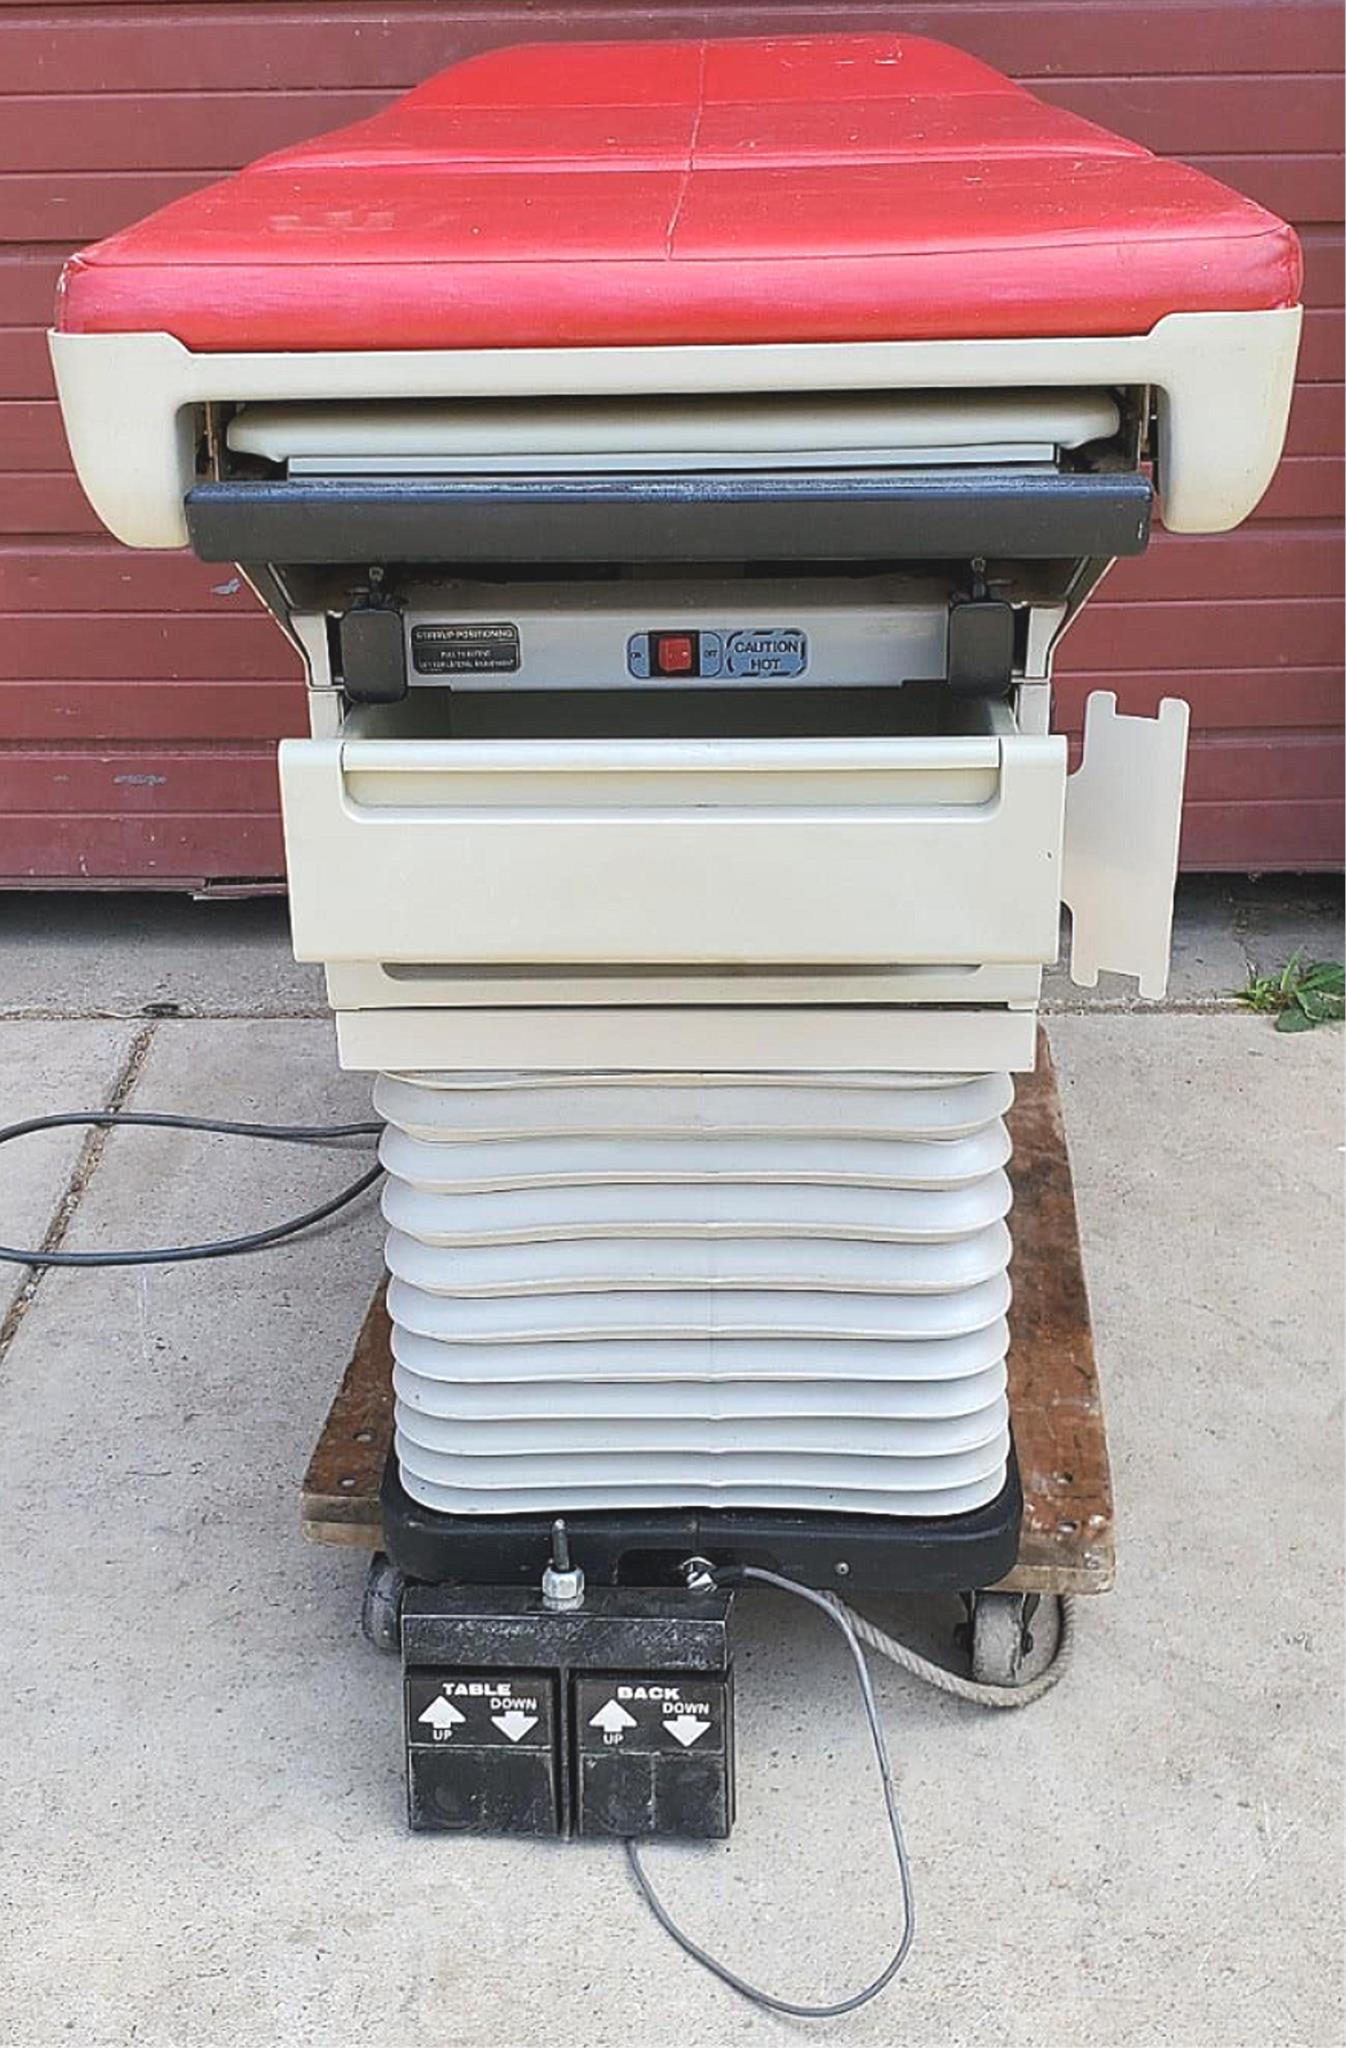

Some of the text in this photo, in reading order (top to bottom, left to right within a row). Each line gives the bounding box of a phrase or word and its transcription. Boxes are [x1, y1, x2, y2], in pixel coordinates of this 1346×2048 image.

[735, 641, 798, 653] CAUTION
[751, 659, 780, 670] HOT
[442, 1683, 511, 1696] TABLE
[617, 1686, 680, 1700] BACK
[490, 1697, 537, 1710] DOWN
[662, 1702, 709, 1714] DOWN
[433, 1729, 453, 1740] UP
[603, 1733, 624, 1744] UP
